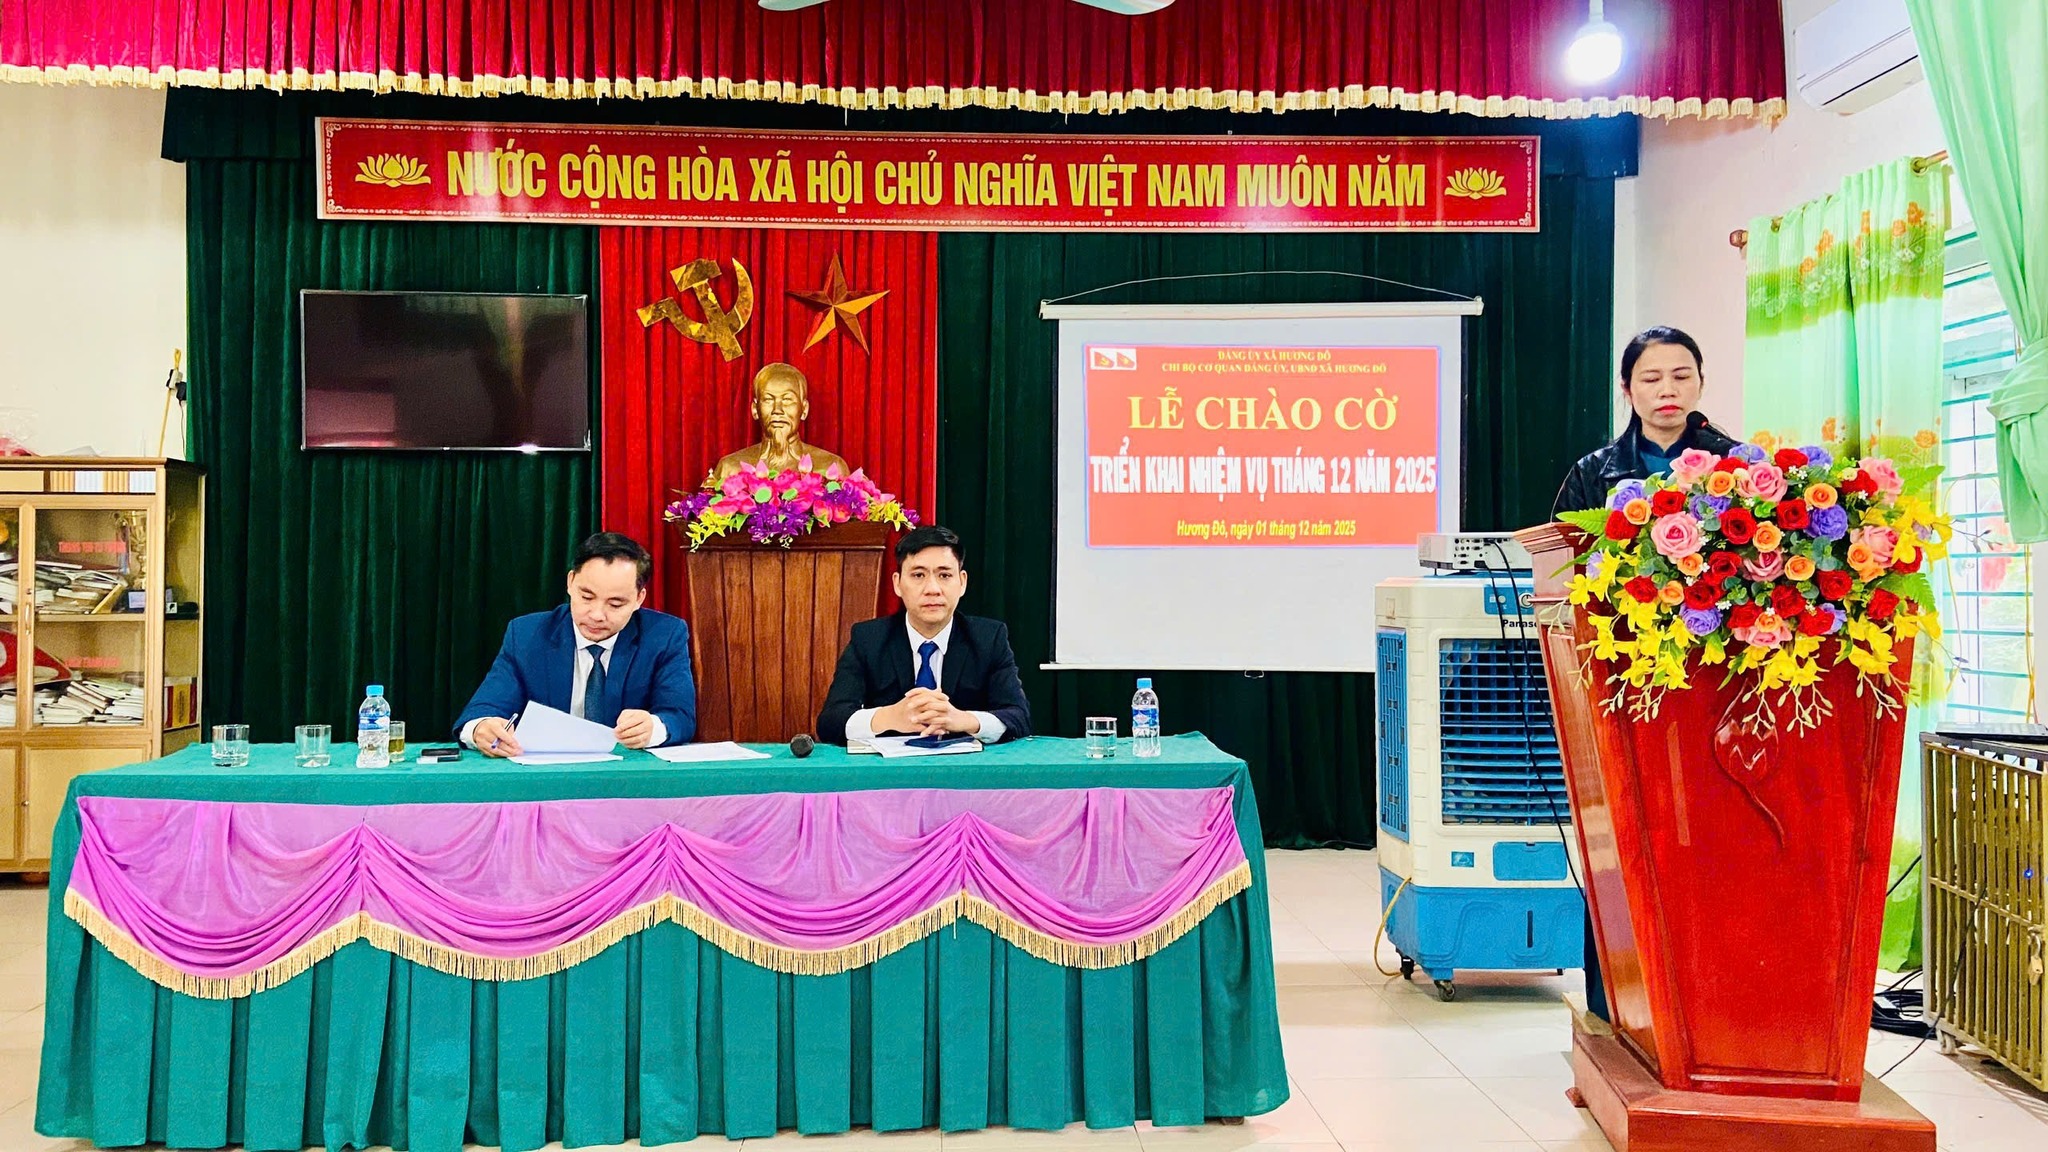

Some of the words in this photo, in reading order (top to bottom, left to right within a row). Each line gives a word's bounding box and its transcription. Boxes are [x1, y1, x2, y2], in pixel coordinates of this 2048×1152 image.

[447, 138, 546, 198] NƯỚC
[558, 145, 656, 209] CỘNG
[668, 145, 739, 202] HÒA
[748, 149, 797, 204] XÃ
[807, 150, 861, 214] HỘI
[874, 149, 941, 206] CHỦ
[954, 153, 1058, 206] NGHĨA
[1067, 154, 1136, 217] VIỆT
[1147, 162, 1226, 208] NAM
[1236, 154, 1335, 208] MUÔN
[1348, 156, 1427, 207] NĂM
[1162, 362, 1180, 372] CHI
[1214, 362, 1242, 374] QUAN
[1127, 386, 1185, 429] LỄ
[1195, 388, 1322, 430] CHÀO
[1334, 388, 1399, 431] CỜ
[1090, 436, 1141, 493] TRIỂN
[1145, 456, 1184, 493] KHAI
[1189, 446, 1241, 502] NHIỆM
[1245, 457, 1268, 502] VỤ
[1271, 446, 1325, 493] THÁNG
[1330, 457, 1350, 493] 12
[1355, 449, 1390, 493] NĂM
[1394, 456, 1436, 493] 2025
[1177, 520, 1210, 540] Hương
[1230, 520, 1254, 540] ngày
[1256, 520, 1267, 536] 01
[1269, 520, 1296, 539] tháng
[1298, 520, 1310, 536] 12
[1311, 520, 1332, 536] năm
[1333, 520, 1357, 536] 2025
